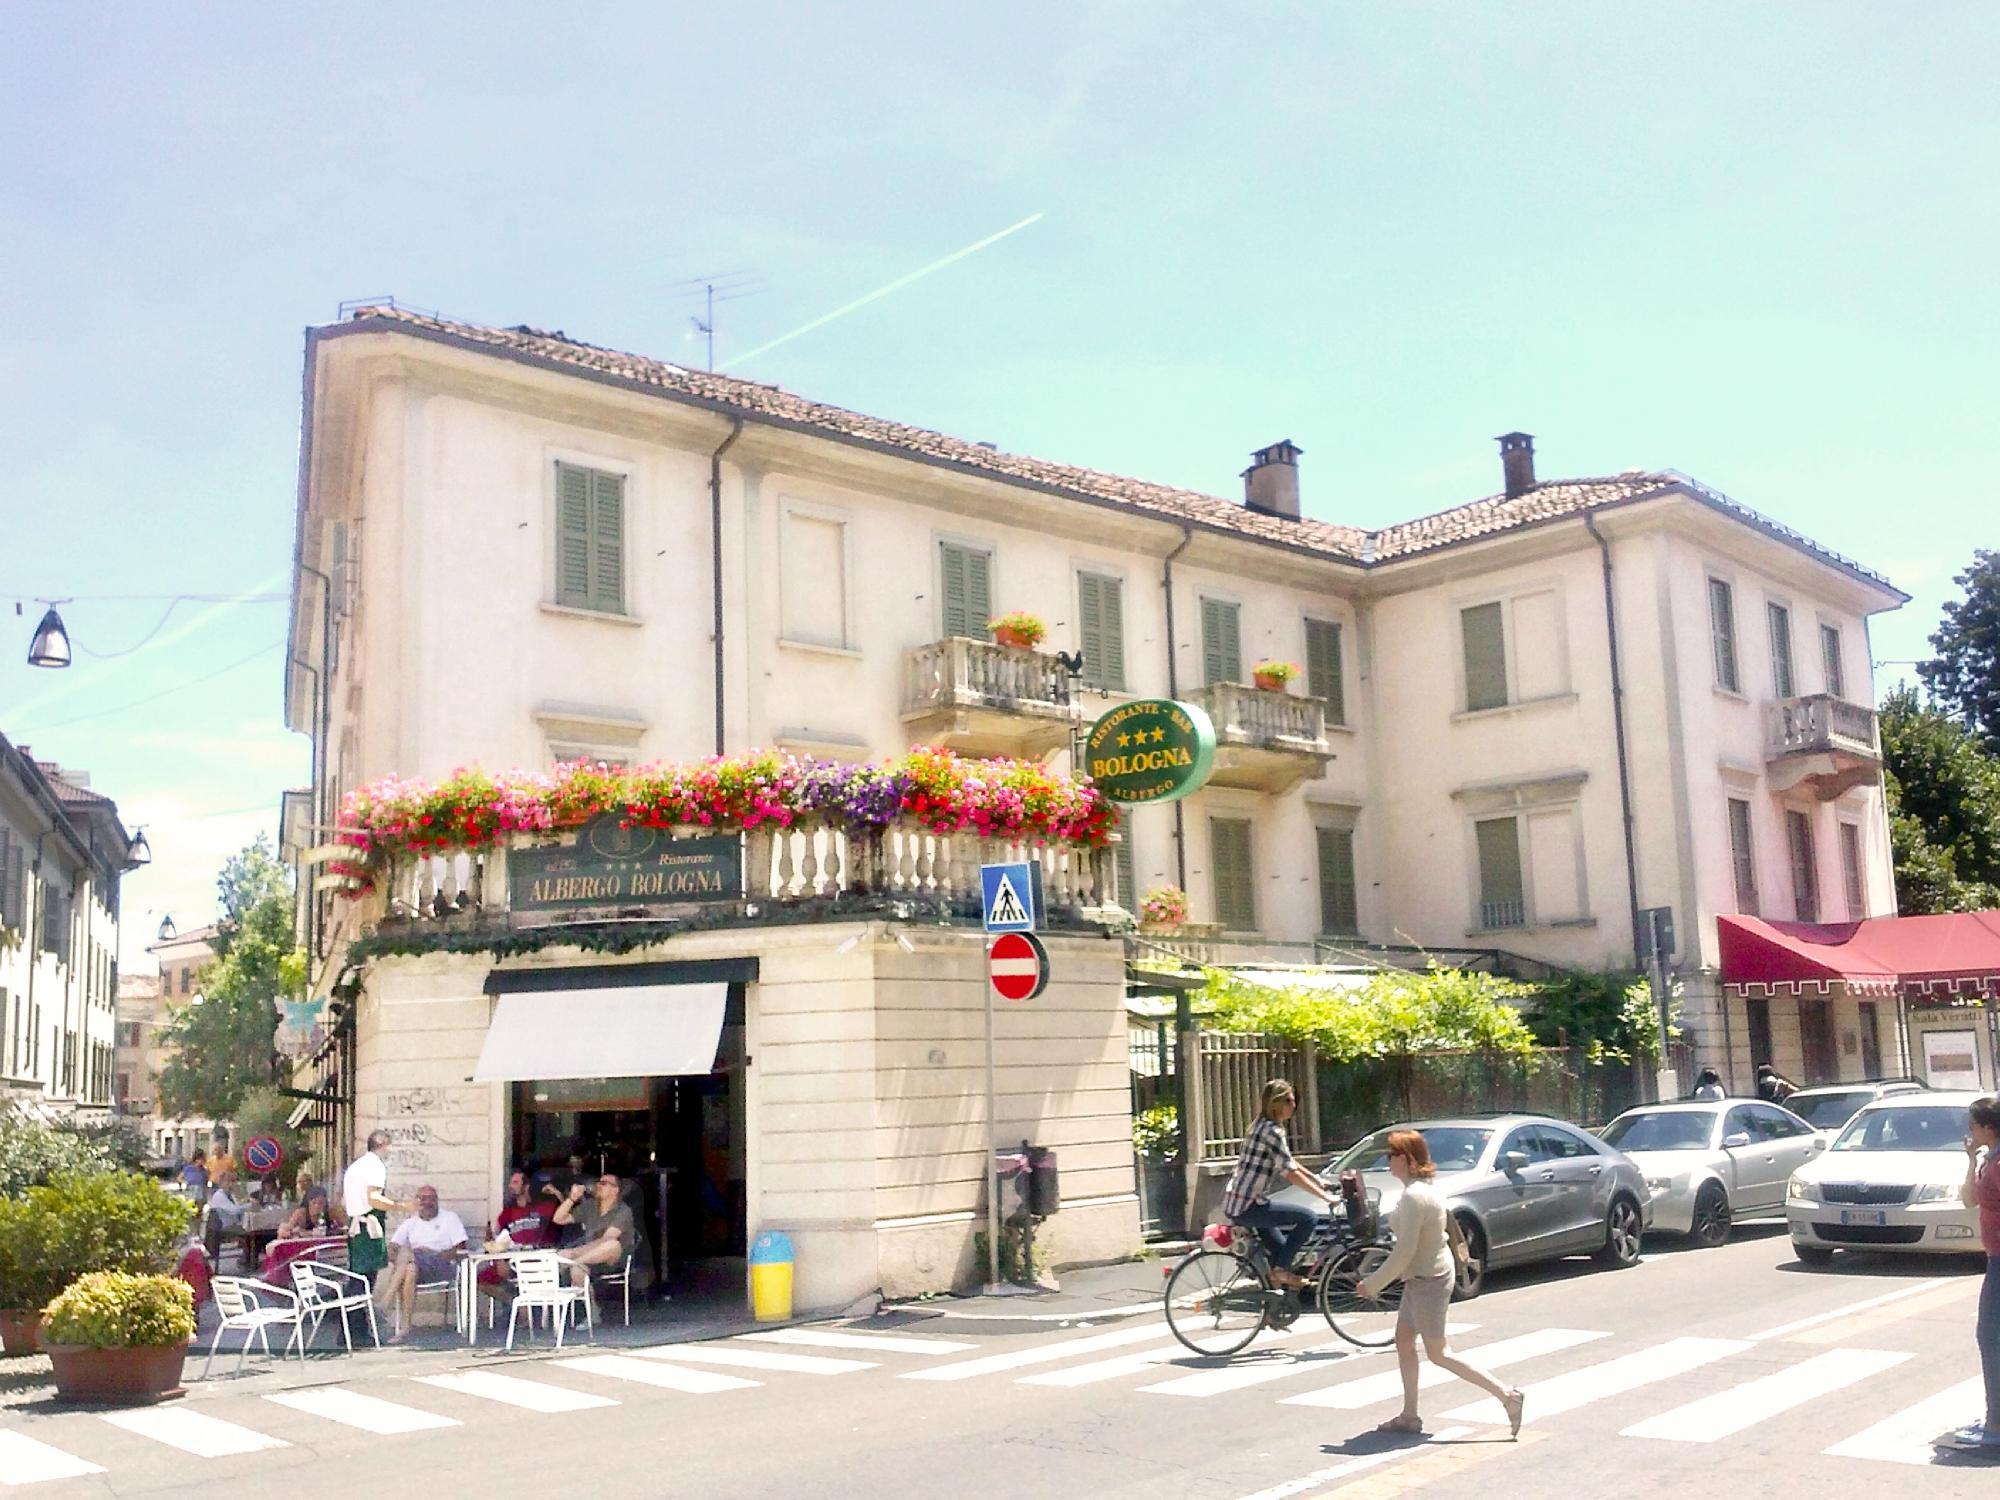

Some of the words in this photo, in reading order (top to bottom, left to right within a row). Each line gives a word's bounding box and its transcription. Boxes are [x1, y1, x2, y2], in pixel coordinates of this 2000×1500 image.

[1090, 703, 1159, 749] RISTORANTE
[1170, 709, 1193, 735] BAR
[1093, 746, 1192, 779] BOLOGNA
[1114, 779, 1174, 800] ALBERGO
[658, 853, 715, 866] Ristorante
[529, 876, 620, 901] ALBERGO
[630, 870, 722, 896] BOLOGNA
